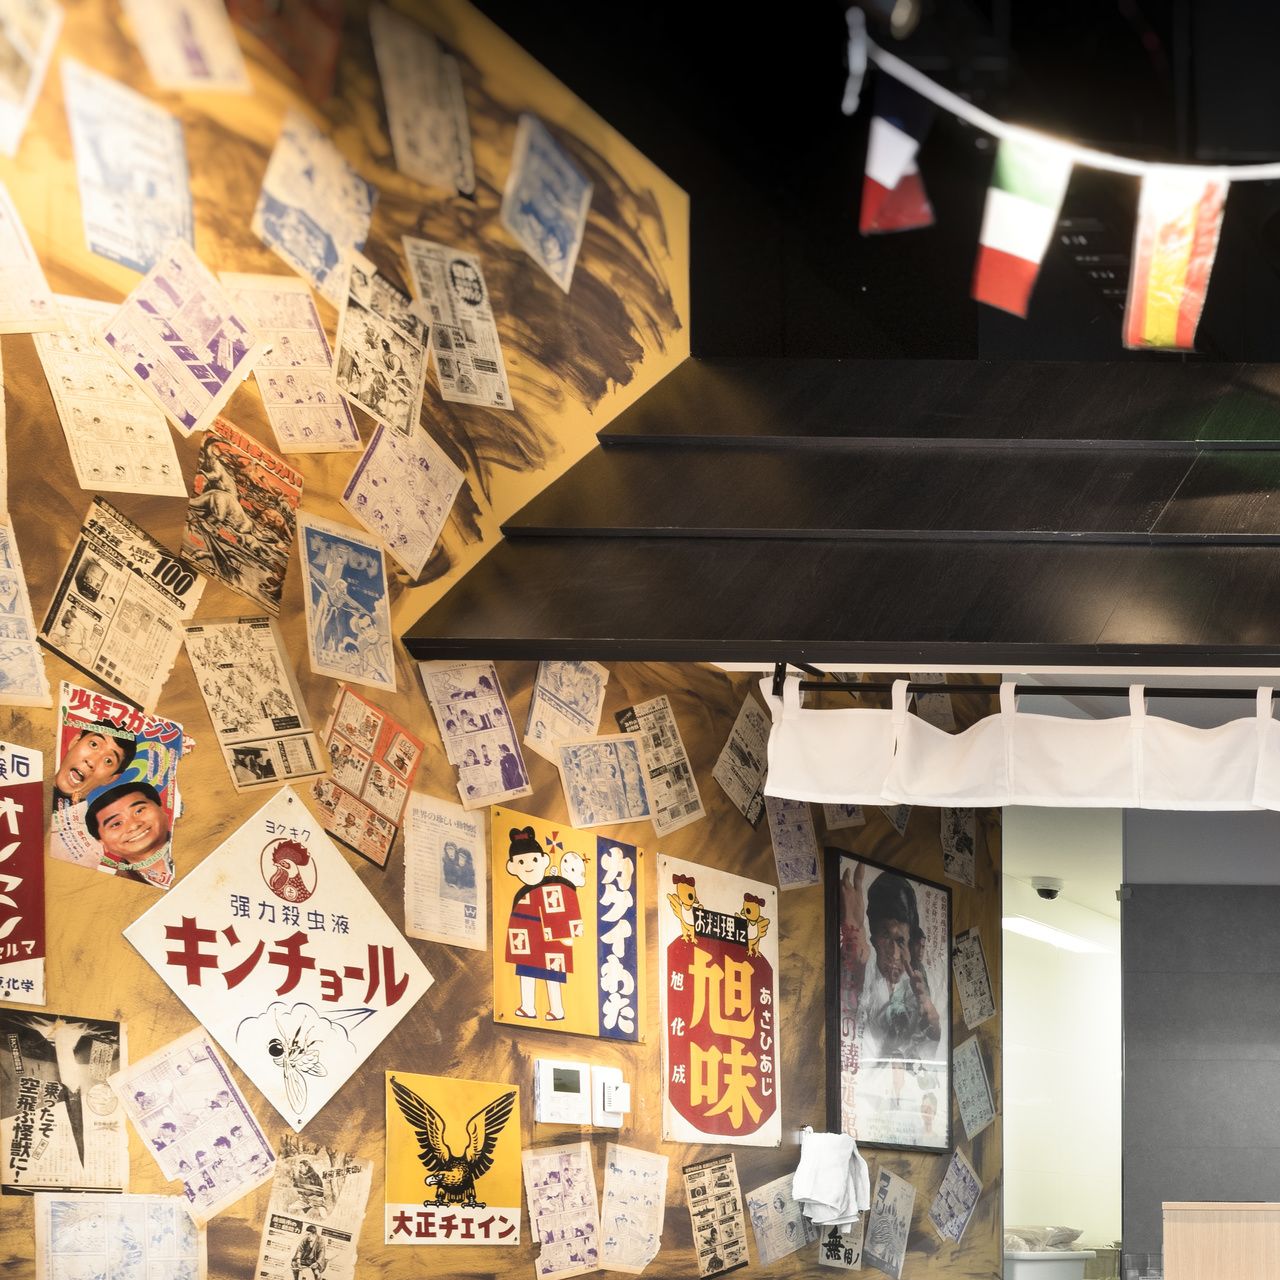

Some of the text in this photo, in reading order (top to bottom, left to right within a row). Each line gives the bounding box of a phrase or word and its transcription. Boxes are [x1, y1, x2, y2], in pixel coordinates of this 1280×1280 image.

[152, 554, 196, 597] 100
[69, 689, 181, 743] 少年マガジン
[266, 820, 311, 843] ヨクキク
[164, 915, 410, 1007] キンチョール
[600, 847, 635, 1034] カクイわた
[695, 909, 747, 944] お料理に
[670, 971, 686, 1085] 旭化成
[688, 946, 763, 1129] 旭味
[760, 987, 773, 1097] あさひあじ
